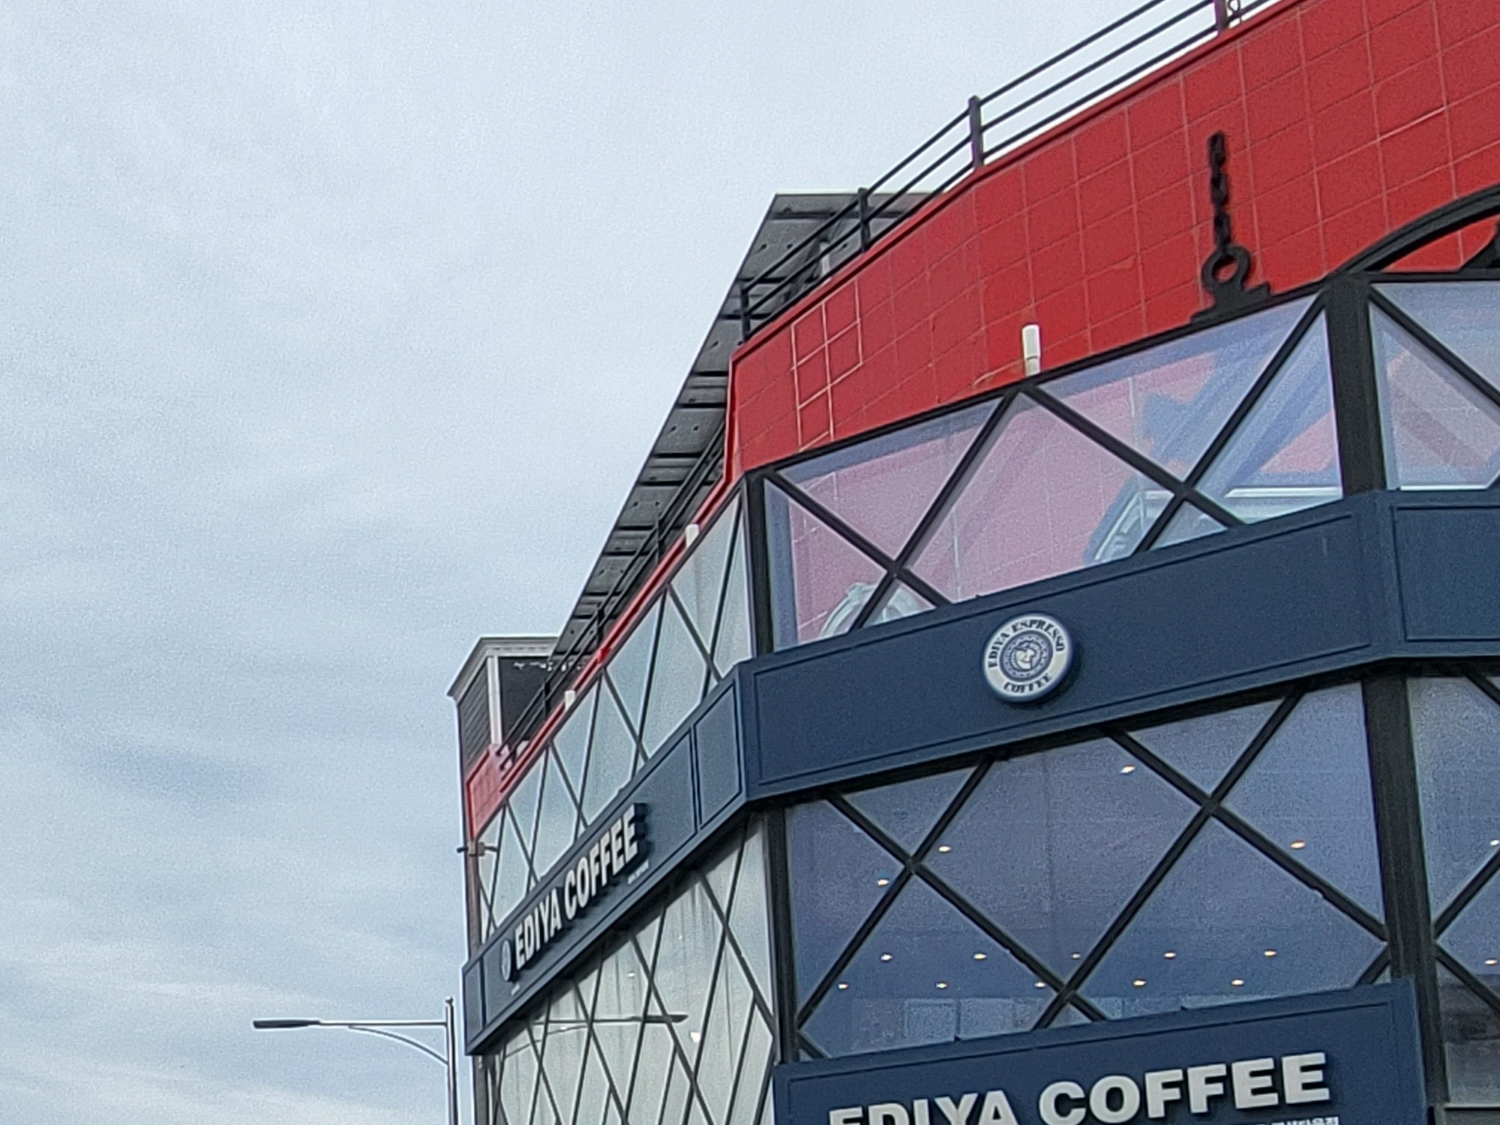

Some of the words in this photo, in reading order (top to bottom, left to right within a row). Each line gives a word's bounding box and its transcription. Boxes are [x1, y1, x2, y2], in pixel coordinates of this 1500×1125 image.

[1003, 673, 1052, 694] COFFEE
[514, 888, 563, 971] EDIYA
[564, 803, 638, 921] COFFEE
